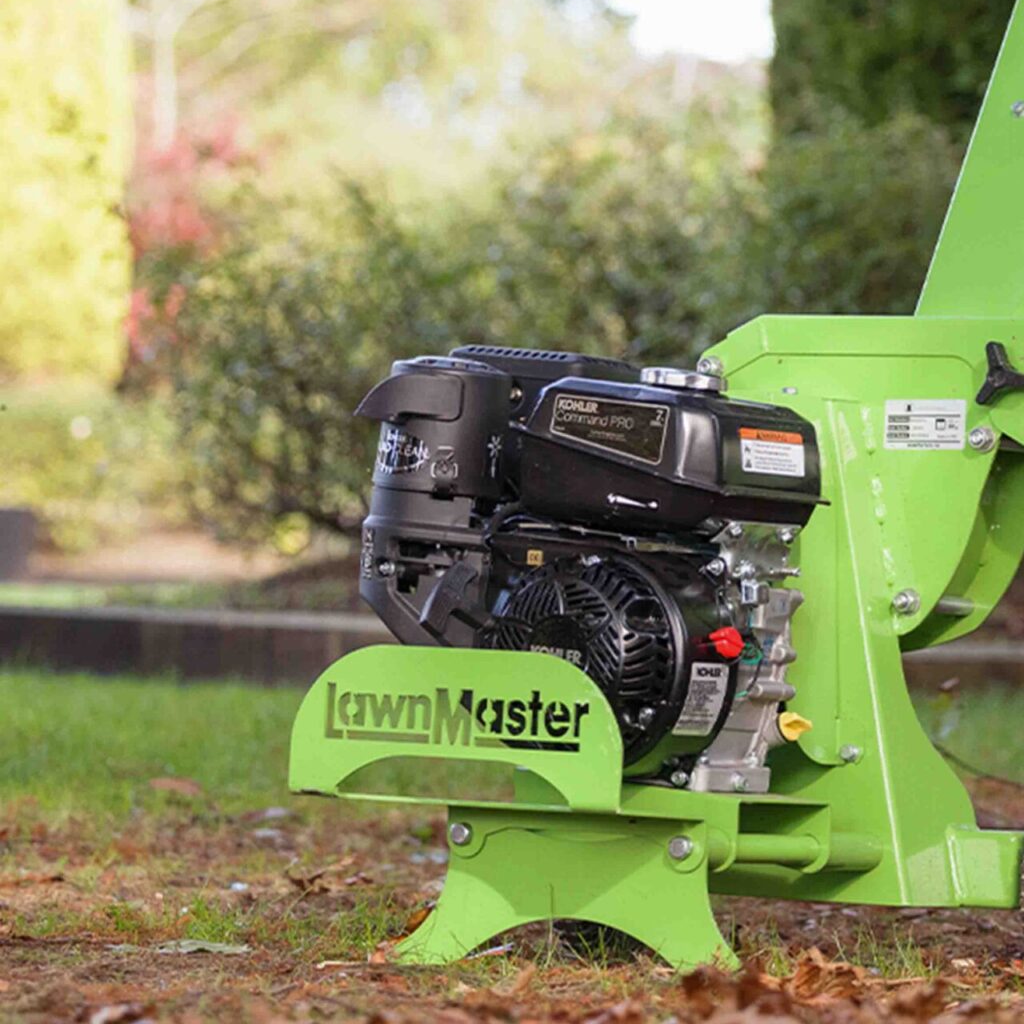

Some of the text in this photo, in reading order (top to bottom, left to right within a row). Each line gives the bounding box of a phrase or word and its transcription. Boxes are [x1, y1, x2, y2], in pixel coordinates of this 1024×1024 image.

[557, 398, 599, 414] KOHLER
[554, 410, 608, 427] Command
[609, 415, 635, 430] PRO
[324, 681, 590, 751] LawnMaster
